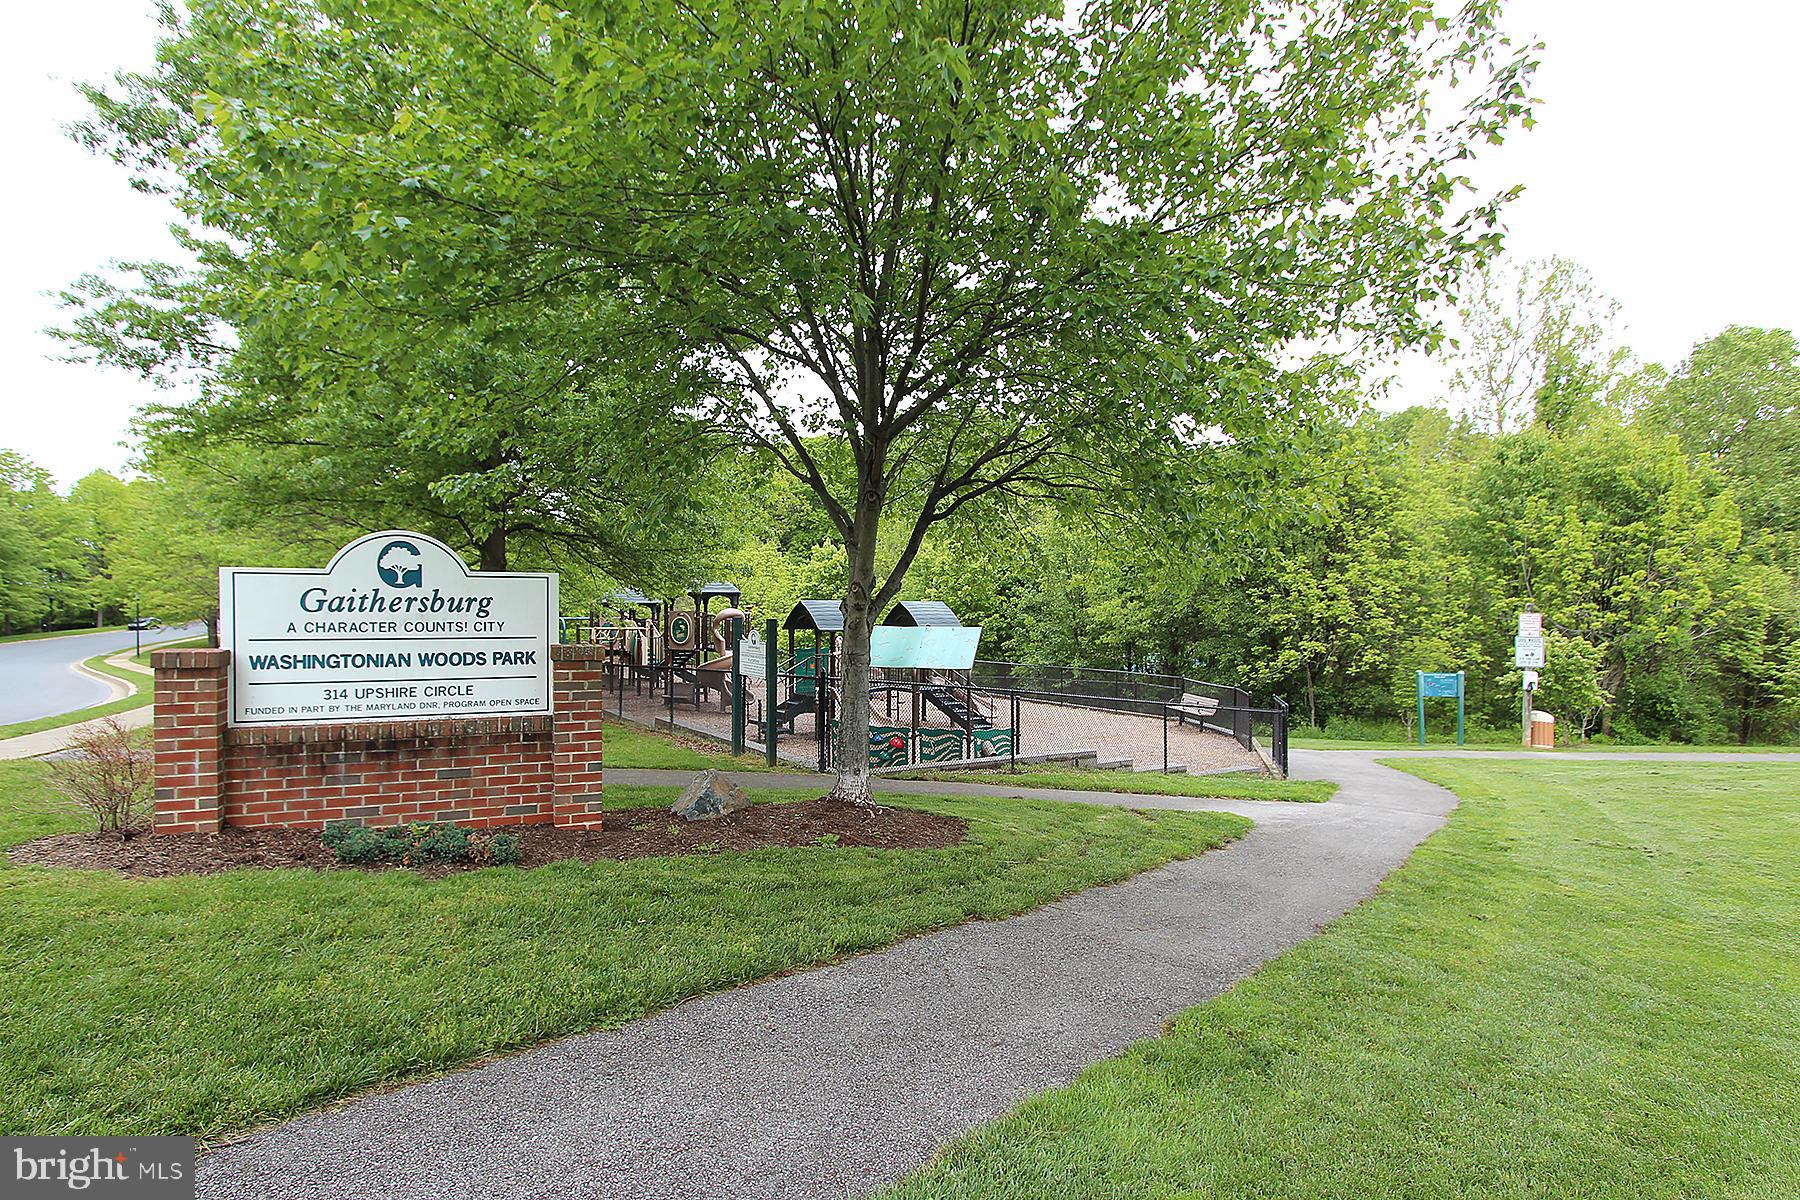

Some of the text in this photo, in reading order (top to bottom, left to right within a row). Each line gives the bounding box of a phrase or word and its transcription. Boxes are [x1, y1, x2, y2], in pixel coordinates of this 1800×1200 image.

[299, 587, 493, 619] Gaithersburg
[286, 621, 505, 634] A CHARACTER COUNTS! CITY
[248, 650, 537, 670] WASHINGTONIAN WOODS PARK
[323, 685, 474, 701] 314 UPSHIRE CIRCLE
[244, 706, 285, 716] FUNDED
[288, 706, 298, 714] IN
[301, 705, 325, 714] PART
[328, 705, 341, 713] BY
[345, 703, 363, 712] THE
[366, 702, 416, 712] MARYLAND
[443, 700, 486, 709] PROGRAM
[489, 699, 512, 707] OPEN
[515, 698, 540, 706] SPACE
